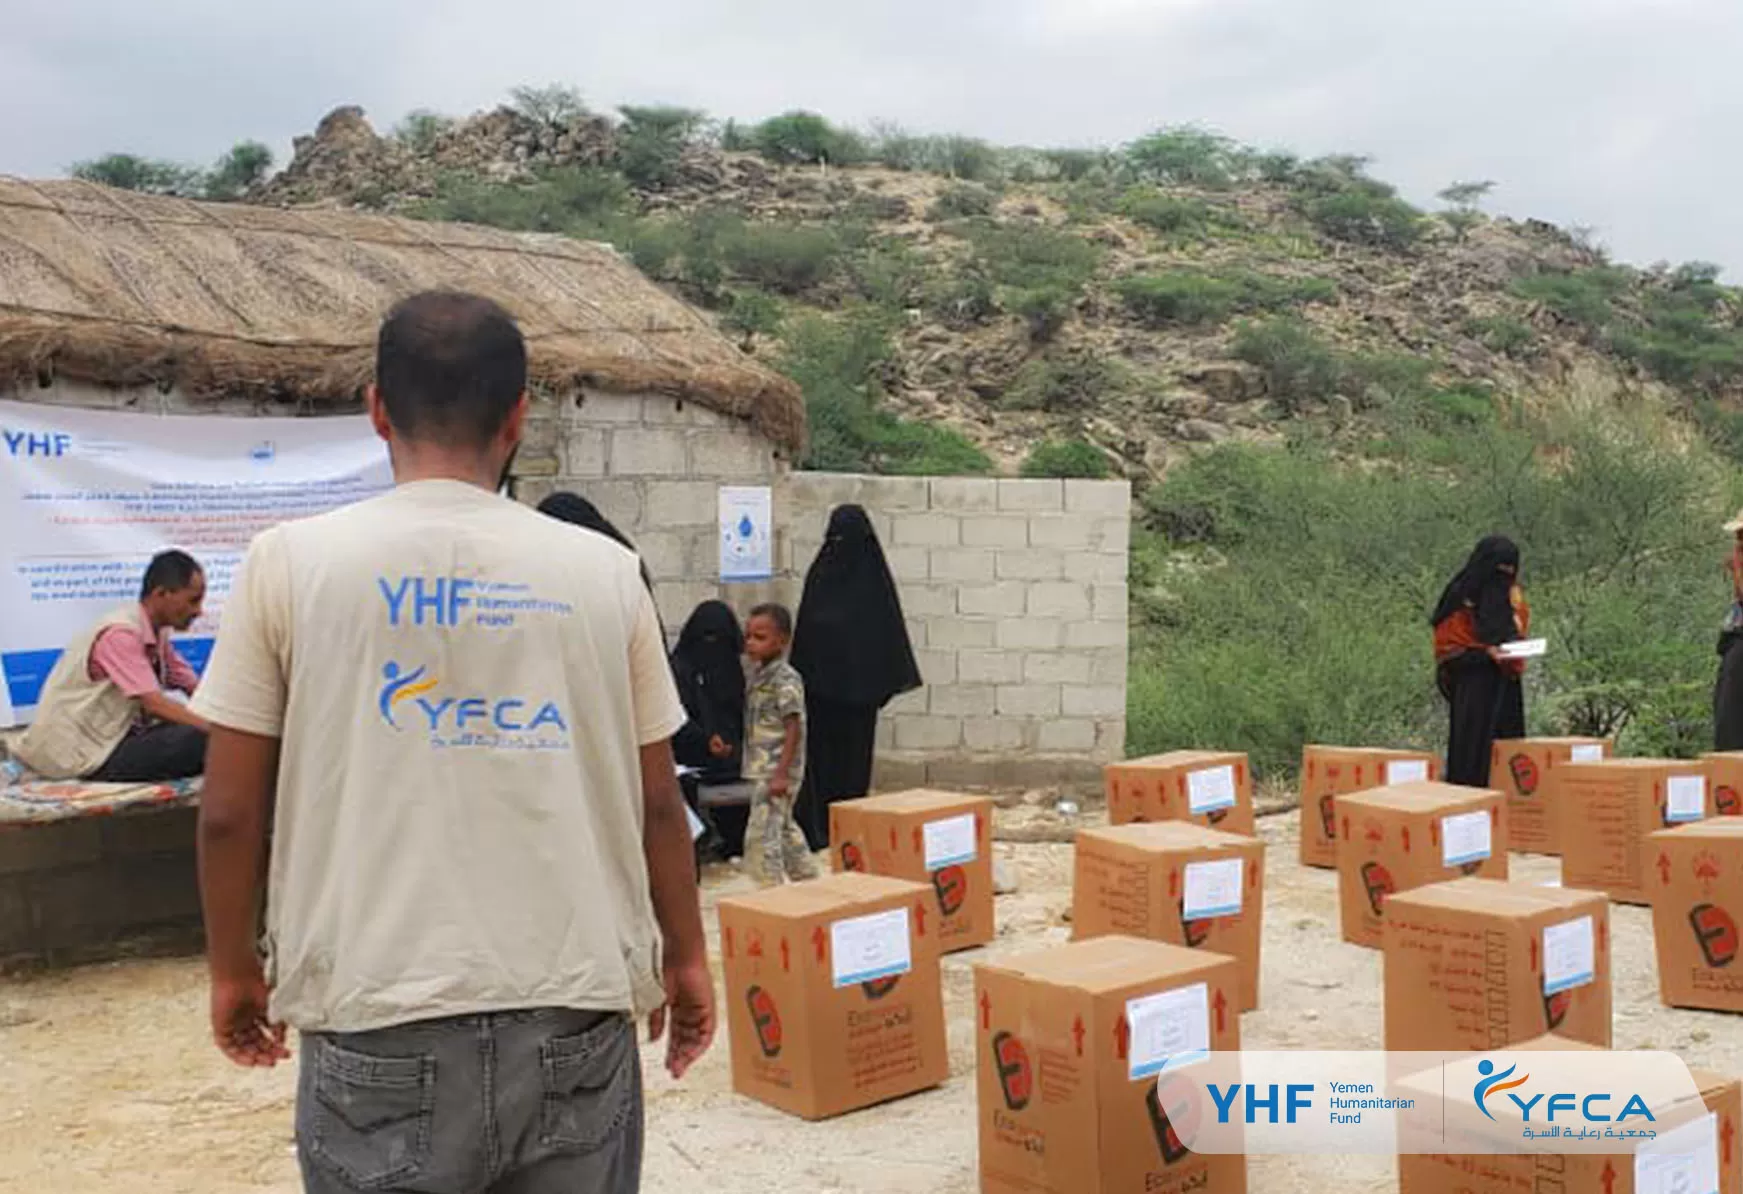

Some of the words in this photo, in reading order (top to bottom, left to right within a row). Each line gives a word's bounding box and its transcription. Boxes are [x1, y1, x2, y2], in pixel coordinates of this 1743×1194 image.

[2, 430, 72, 457] YHF
[377, 577, 474, 626] YHF
[415, 697, 567, 731] YFCA
